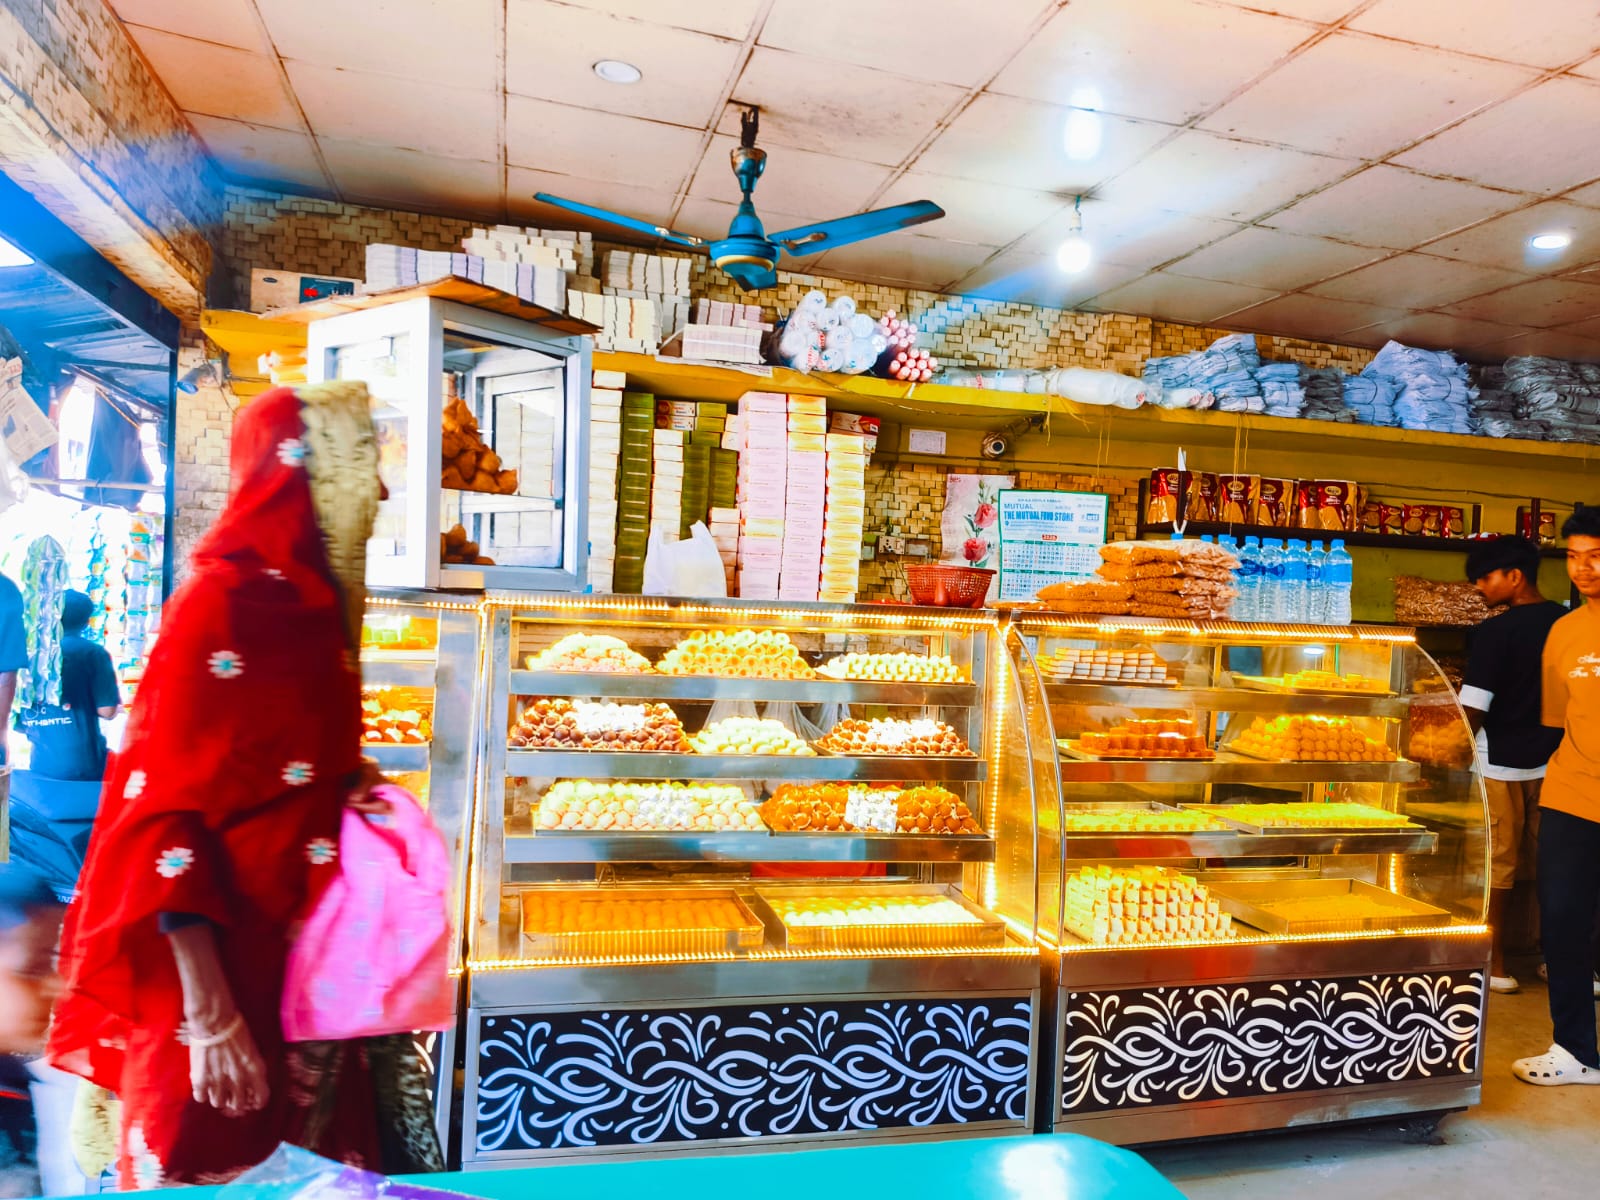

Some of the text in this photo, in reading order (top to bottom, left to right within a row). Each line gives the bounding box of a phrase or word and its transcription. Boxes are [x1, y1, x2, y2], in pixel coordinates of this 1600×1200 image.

[1004, 511, 1015, 520] THE
[1015, 511, 1039, 520] MUTUAL
[1054, 512, 1074, 522] STORE
[22, 717, 73, 727] THENTIC
